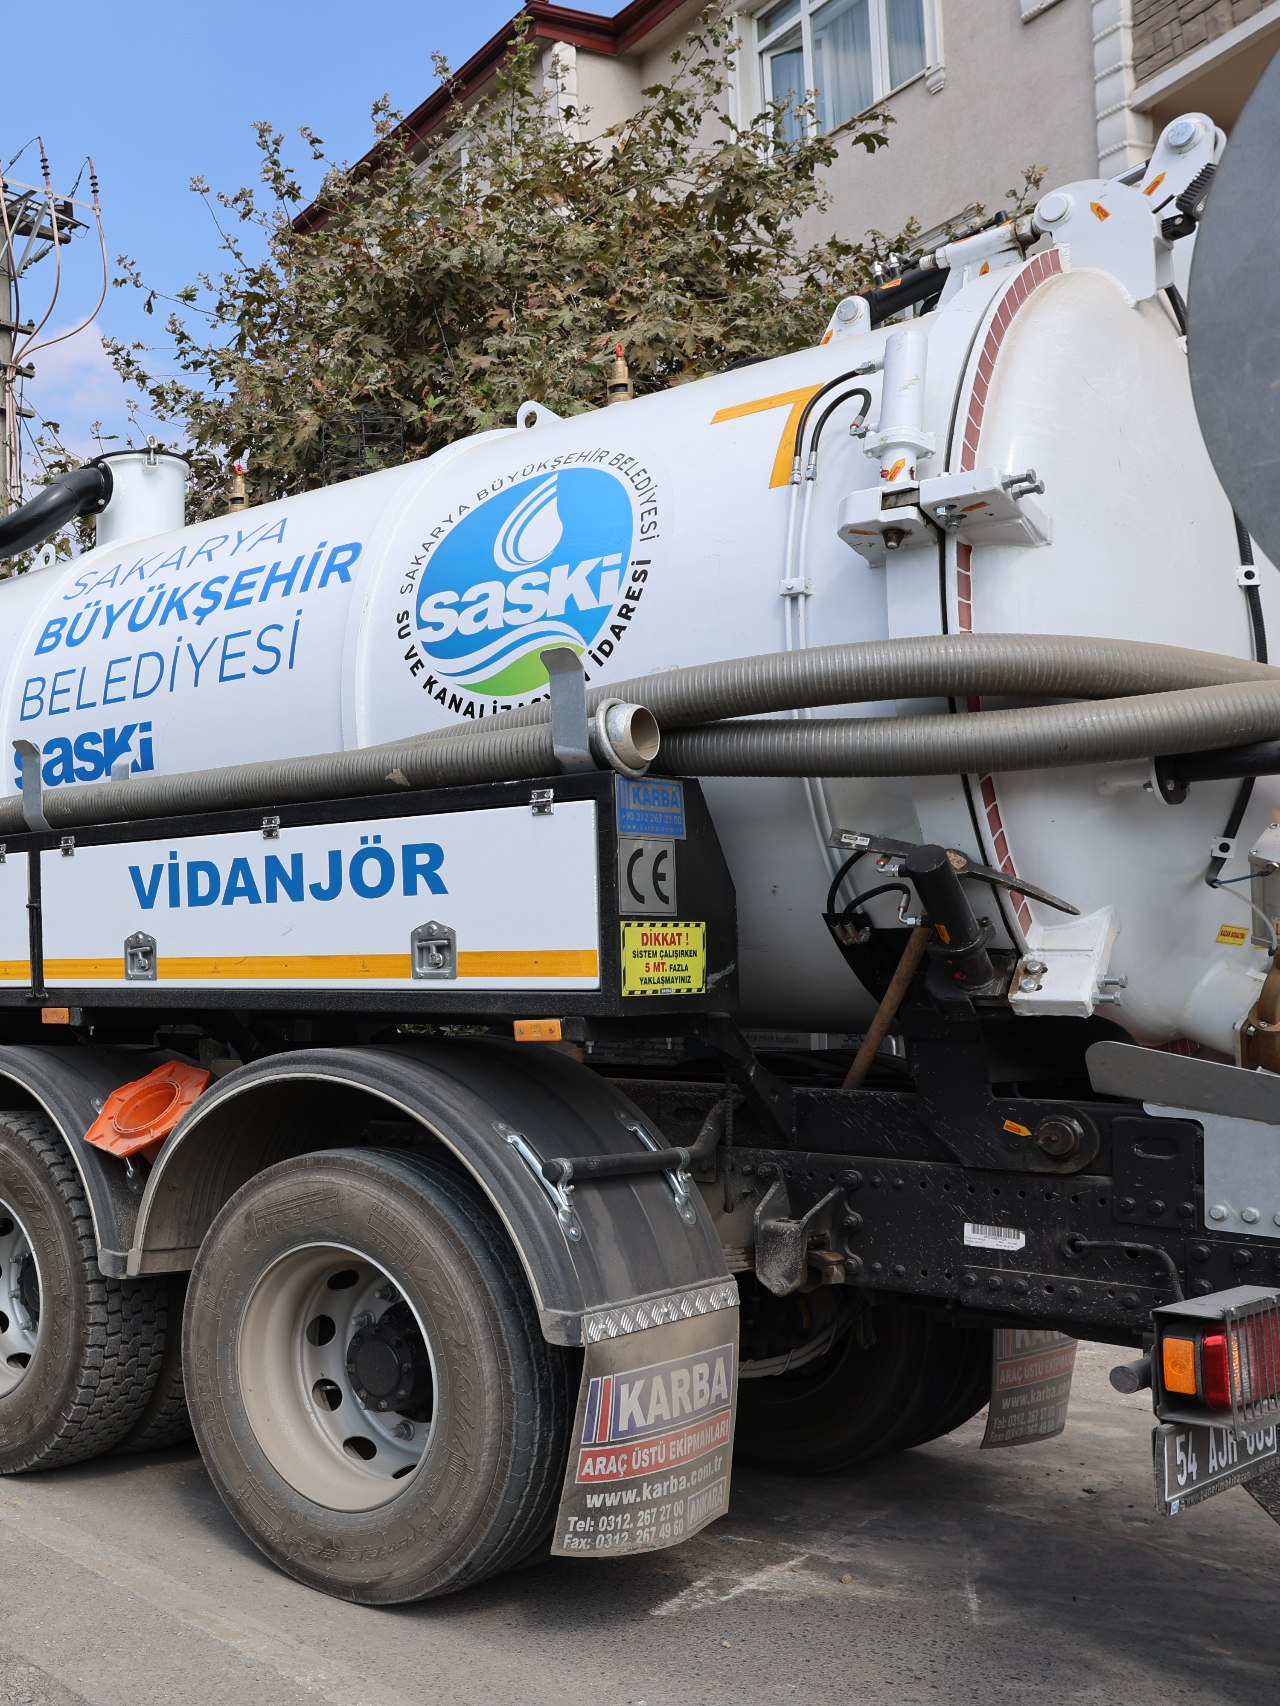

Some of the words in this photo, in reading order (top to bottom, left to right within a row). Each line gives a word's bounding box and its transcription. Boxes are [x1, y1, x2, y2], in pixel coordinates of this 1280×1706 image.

[400, 504, 470, 595] SAKARYA
[476, 448, 609, 501] BÜYÜKŞEHİR
[608, 452, 660, 542] BELEDİYESİ
[62, 517, 288, 600] SAKARYA
[34, 541, 363, 656] BÜYÜKŞEHİR
[397, 609, 411, 640] SU
[587, 559, 651, 667] İDARESİ
[20, 608, 303, 722] BELEDİYESİ
[403, 644, 424, 677] VE
[631, 786, 680, 808] KARBA
[128, 834, 449, 910] VİDANJÖR
[632, 947, 658, 959] SİSTEM
[659, 949, 698, 961] ÇALIŞIRKEN
[641, 928, 683, 947] DİKKAT
[685, 931, 690, 946] !
[639, 975, 692, 987] YAKLAŞMAYINIZ
[644, 962, 651, 973] 5
[653, 961, 668, 973] MT.
[669, 964, 689, 972] FAZLA
[618, 1356, 728, 1432] KARBA
[581, 1453, 628, 1477] ARAÇ
[631, 1441, 666, 1470] ÜSTÜ
[669, 1419, 729, 1455] EKİPMANLARI
[1175, 1430, 1198, 1486] 54
[585, 1454, 723, 1509] www.karba.com.tr
[563, 1533, 591, 1550] Fax:
[567, 1516, 595, 1532] Tel:
[598, 1514, 634, 1532] 0312.
[636, 1507, 657, 1526] 267
[659, 1504, 671, 1520] 27
[673, 1499, 684, 1516] 00
